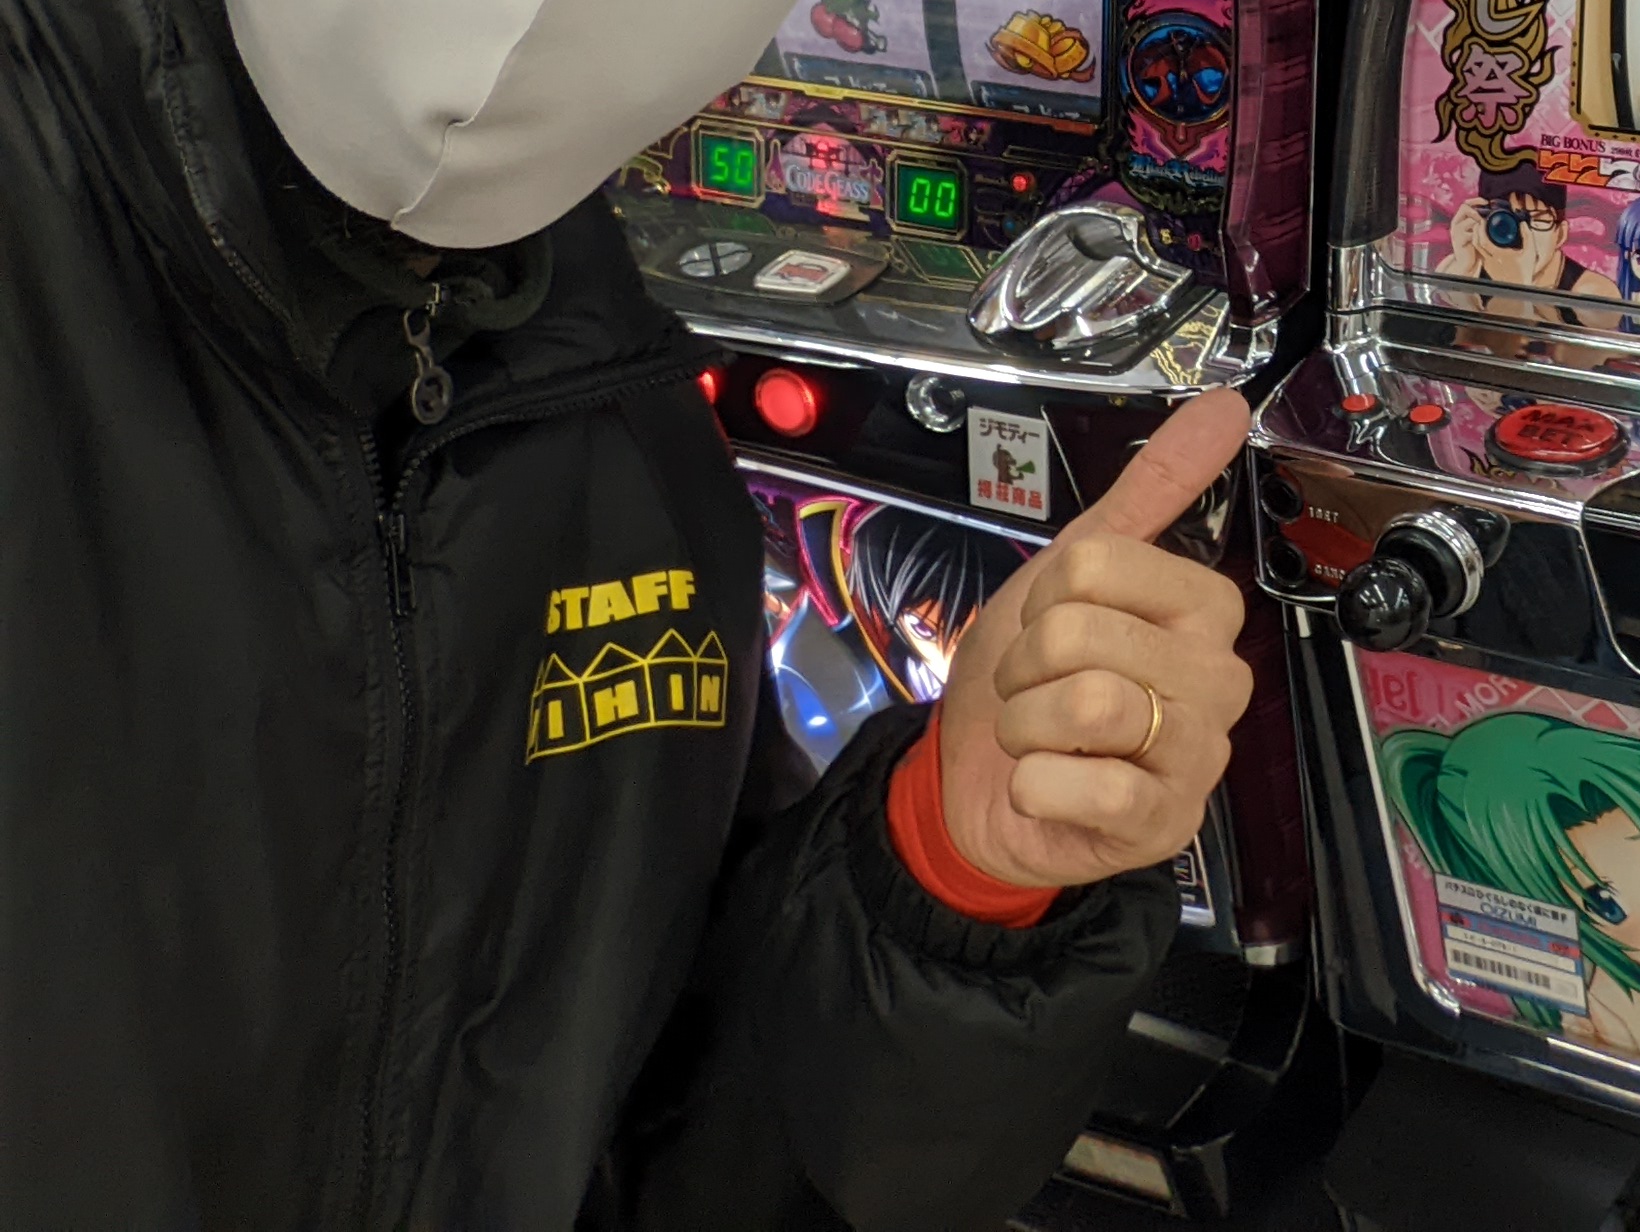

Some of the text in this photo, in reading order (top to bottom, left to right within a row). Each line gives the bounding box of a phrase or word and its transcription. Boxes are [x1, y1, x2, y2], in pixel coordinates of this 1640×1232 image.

[1541, 134, 1561, 148] BIG
[1563, 137, 1606, 153] BONUS
[711, 145, 756, 192] 50
[909, 177, 956, 218] 00
[979, 418, 1040, 443] ジモティー
[547, 569, 696, 634] STAFF
[528, 674, 721, 751] IHIN
